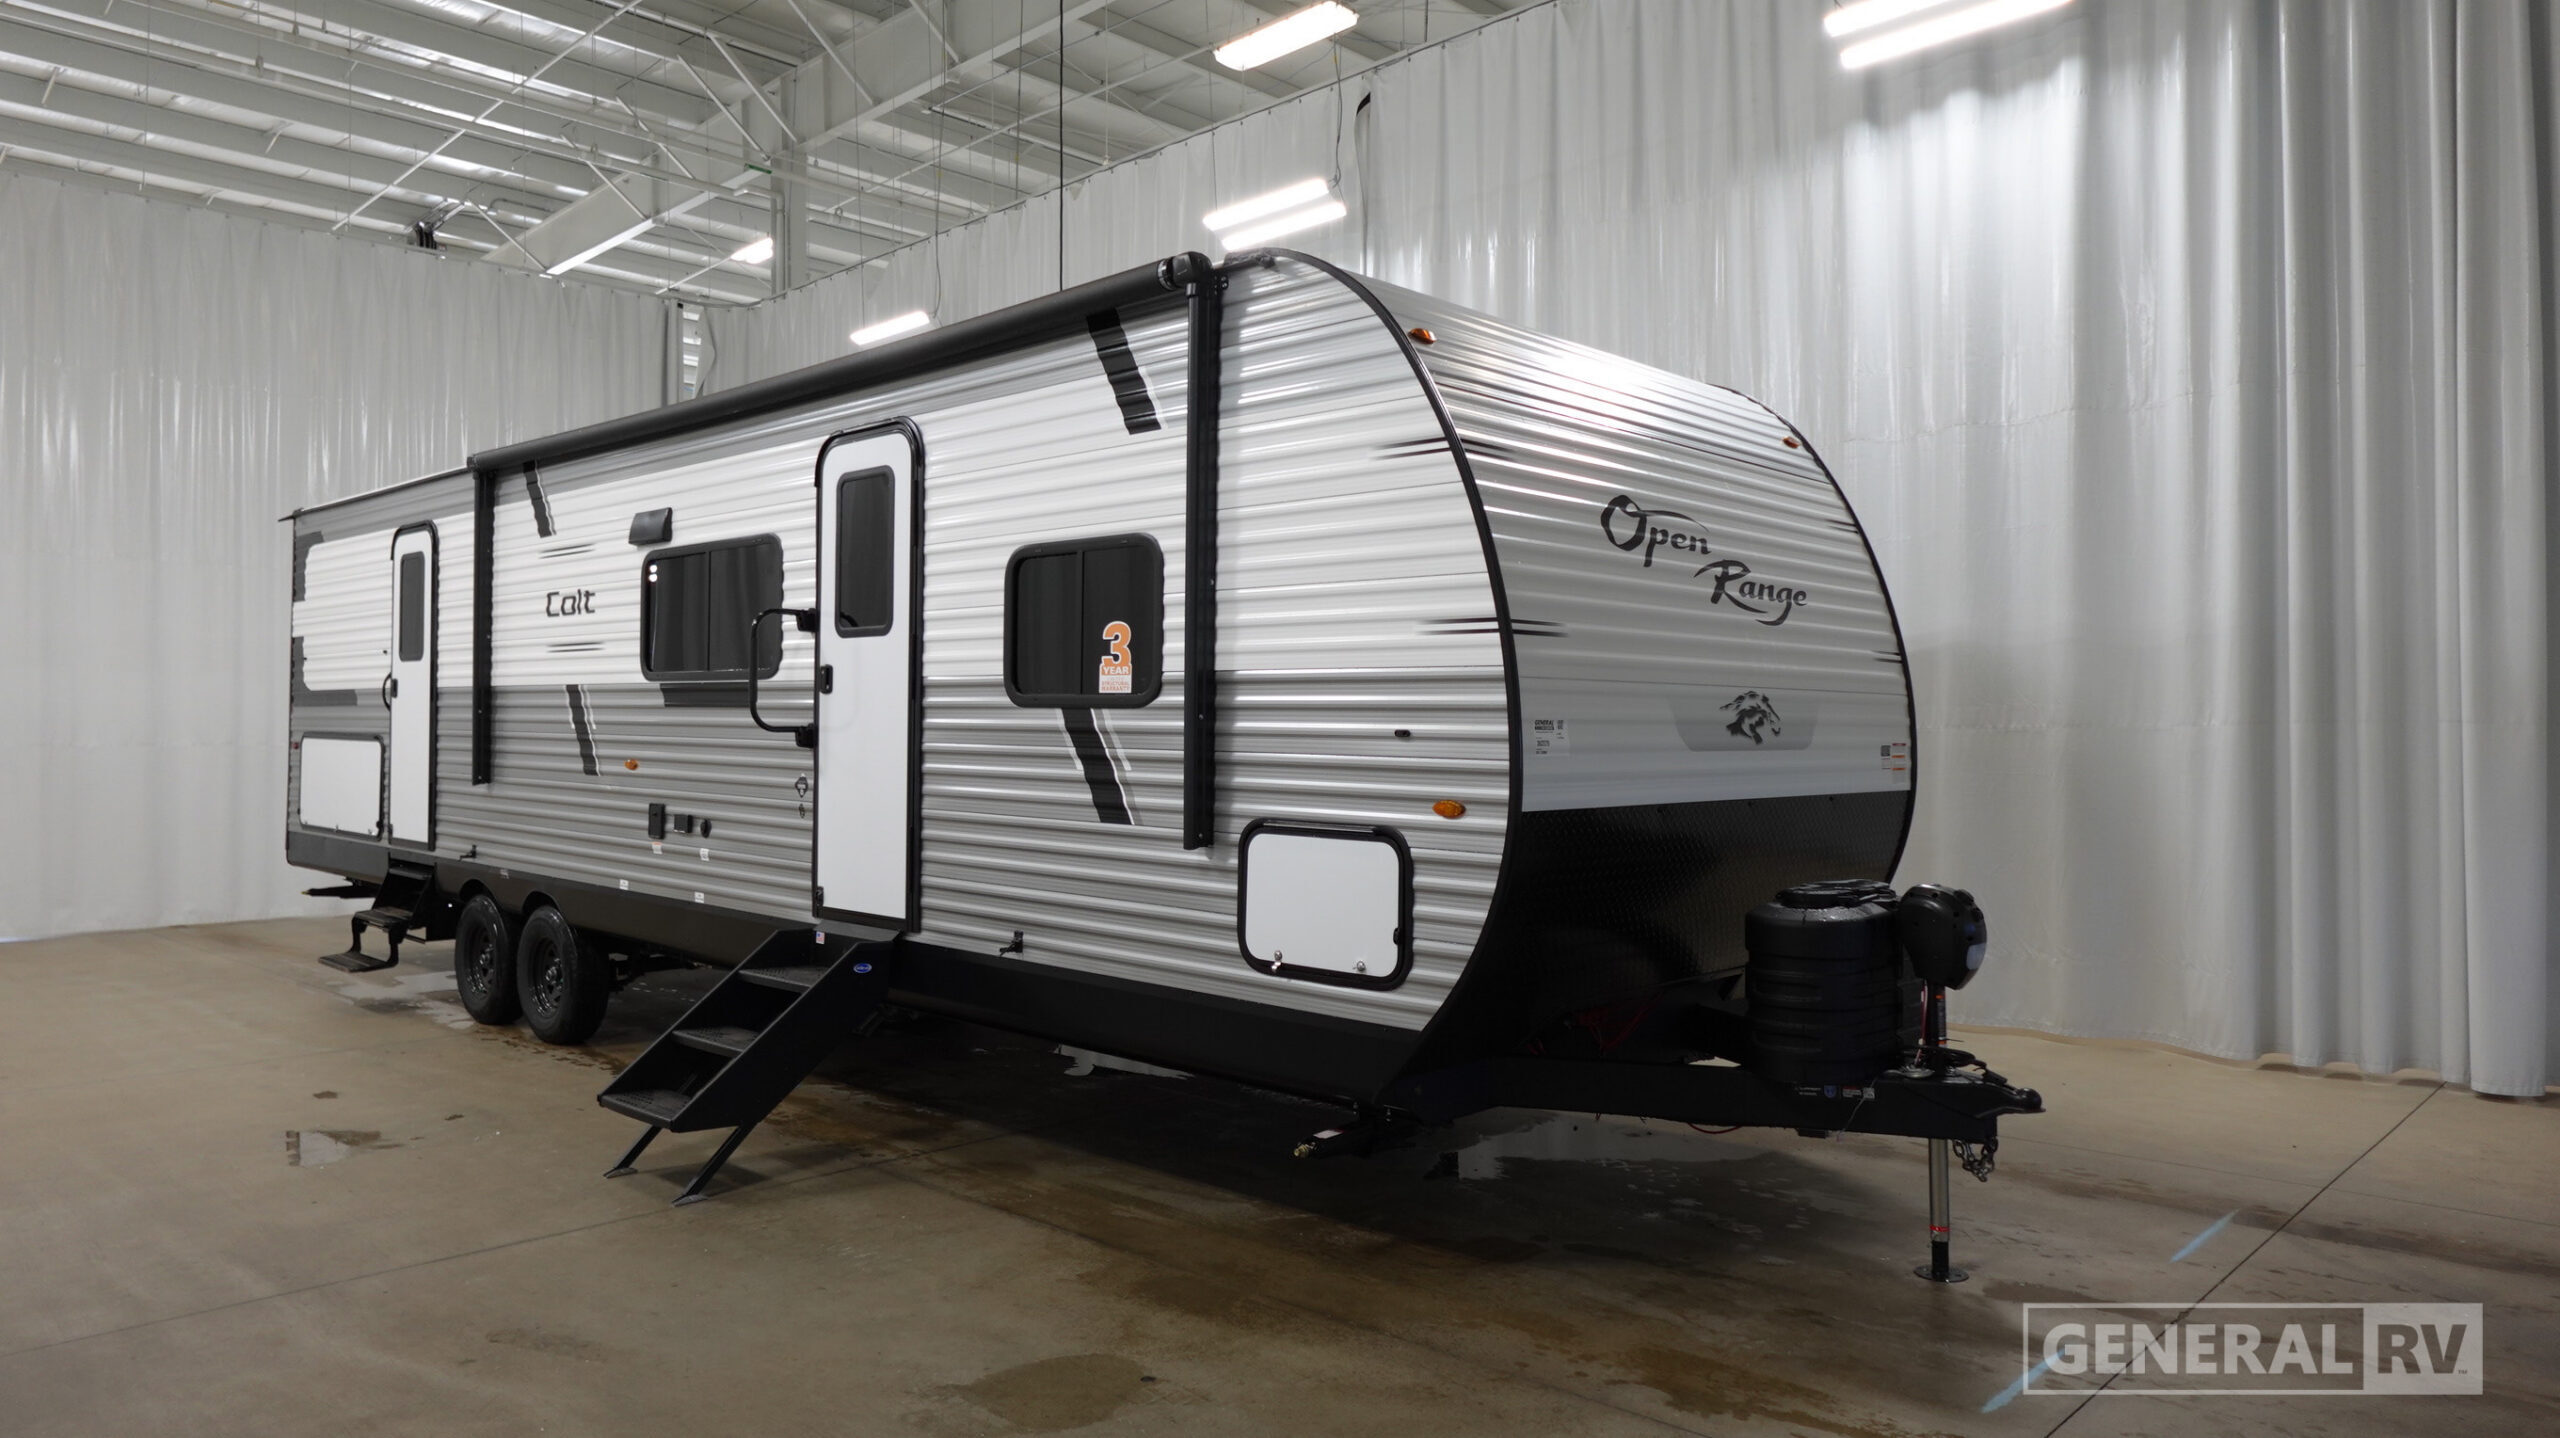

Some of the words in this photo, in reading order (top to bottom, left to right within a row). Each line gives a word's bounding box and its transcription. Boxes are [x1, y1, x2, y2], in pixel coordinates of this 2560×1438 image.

[1601, 495, 1710, 567] Open
[546, 589, 596, 617] Colt
[1694, 559, 1807, 626] Range
[1102, 621, 1131, 665] 3
[1103, 666, 1129, 674] YEAR
